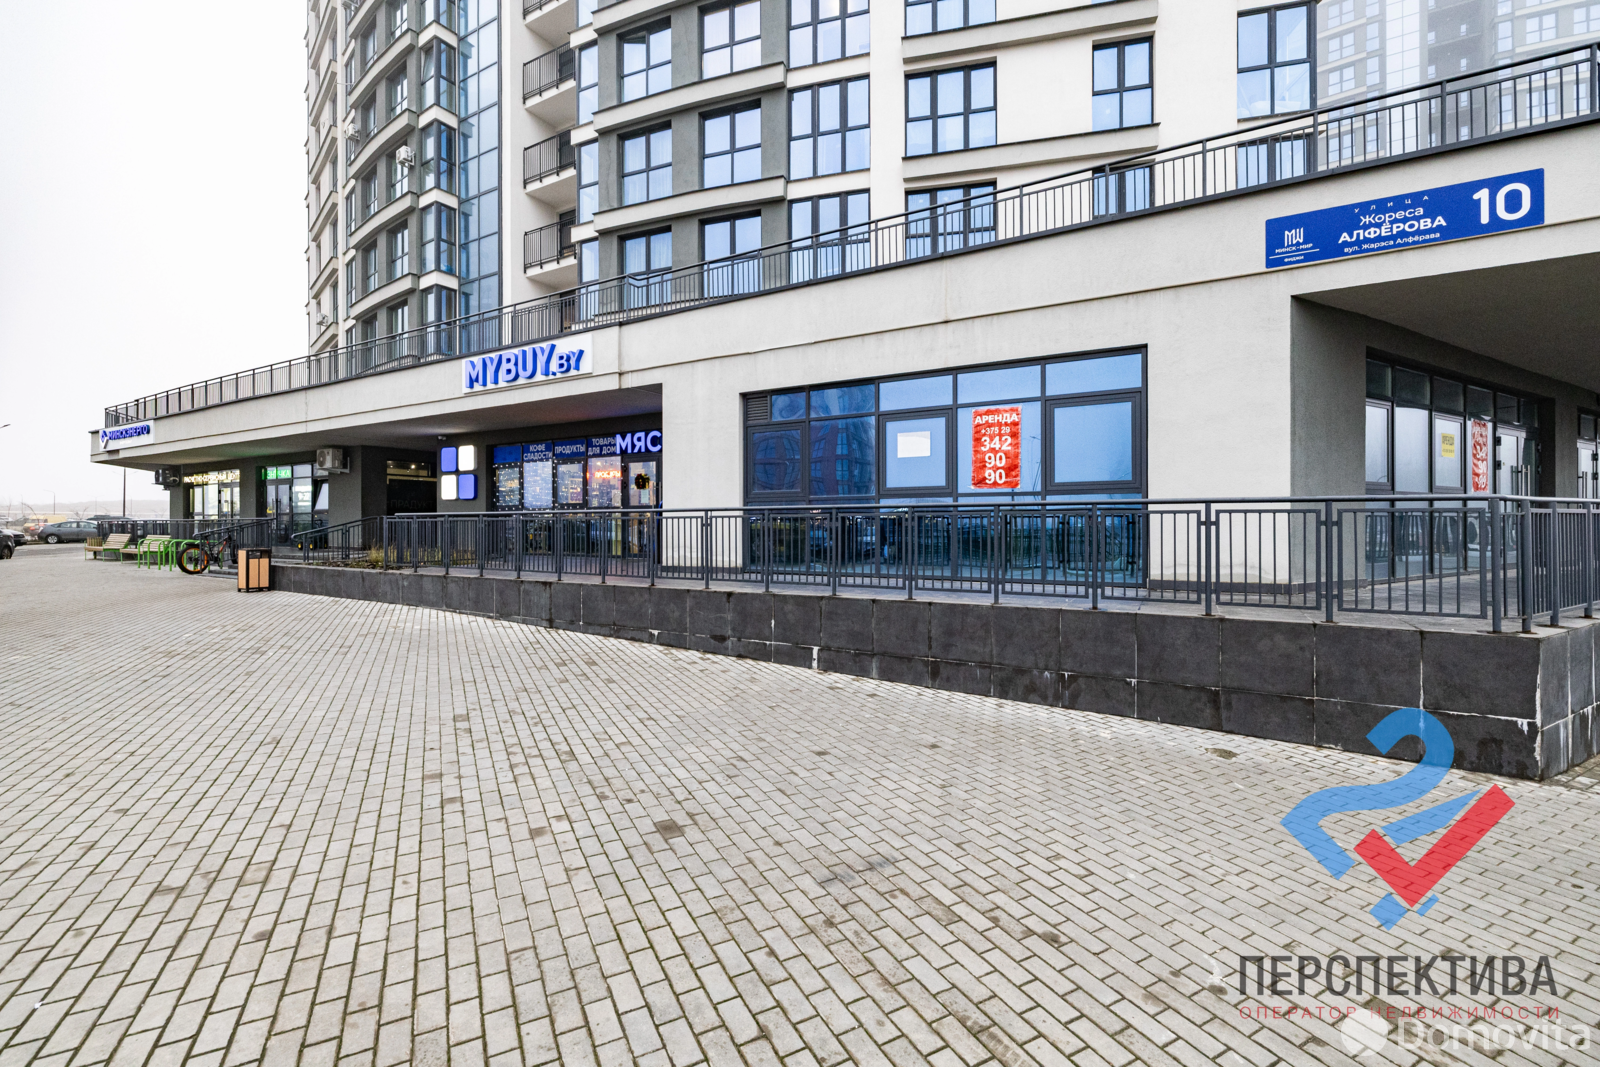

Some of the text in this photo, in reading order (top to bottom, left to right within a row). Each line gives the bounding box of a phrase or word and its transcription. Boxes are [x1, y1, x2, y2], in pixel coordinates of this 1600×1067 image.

[1354, 195, 1429, 213] УЛИЦА
[1472, 182, 1532, 225] 10
[1359, 206, 1424, 226] Жореса
[1338, 215, 1447, 244] АЛФЁРОВА
[1344, 231, 1440, 254] вул. Жарэса Алфёрава
[465, 343, 584, 389] MYBUY.BY
[974, 413, 1019, 424] АРЕНДА
[108, 424, 150, 440] МИНСКЭНЕРГО
[981, 426, 1011, 435] +375 29
[529, 443, 546, 452] КОФЕ
[554, 444, 586, 454] ПРОДУКТЫ
[981, 435, 1012, 451] 342
[523, 451, 553, 461] СЛАДОСТИ
[588, 447, 600, 456] ДЛЯ
[985, 452, 1006, 467] 90
[985, 469, 1006, 484] 90
